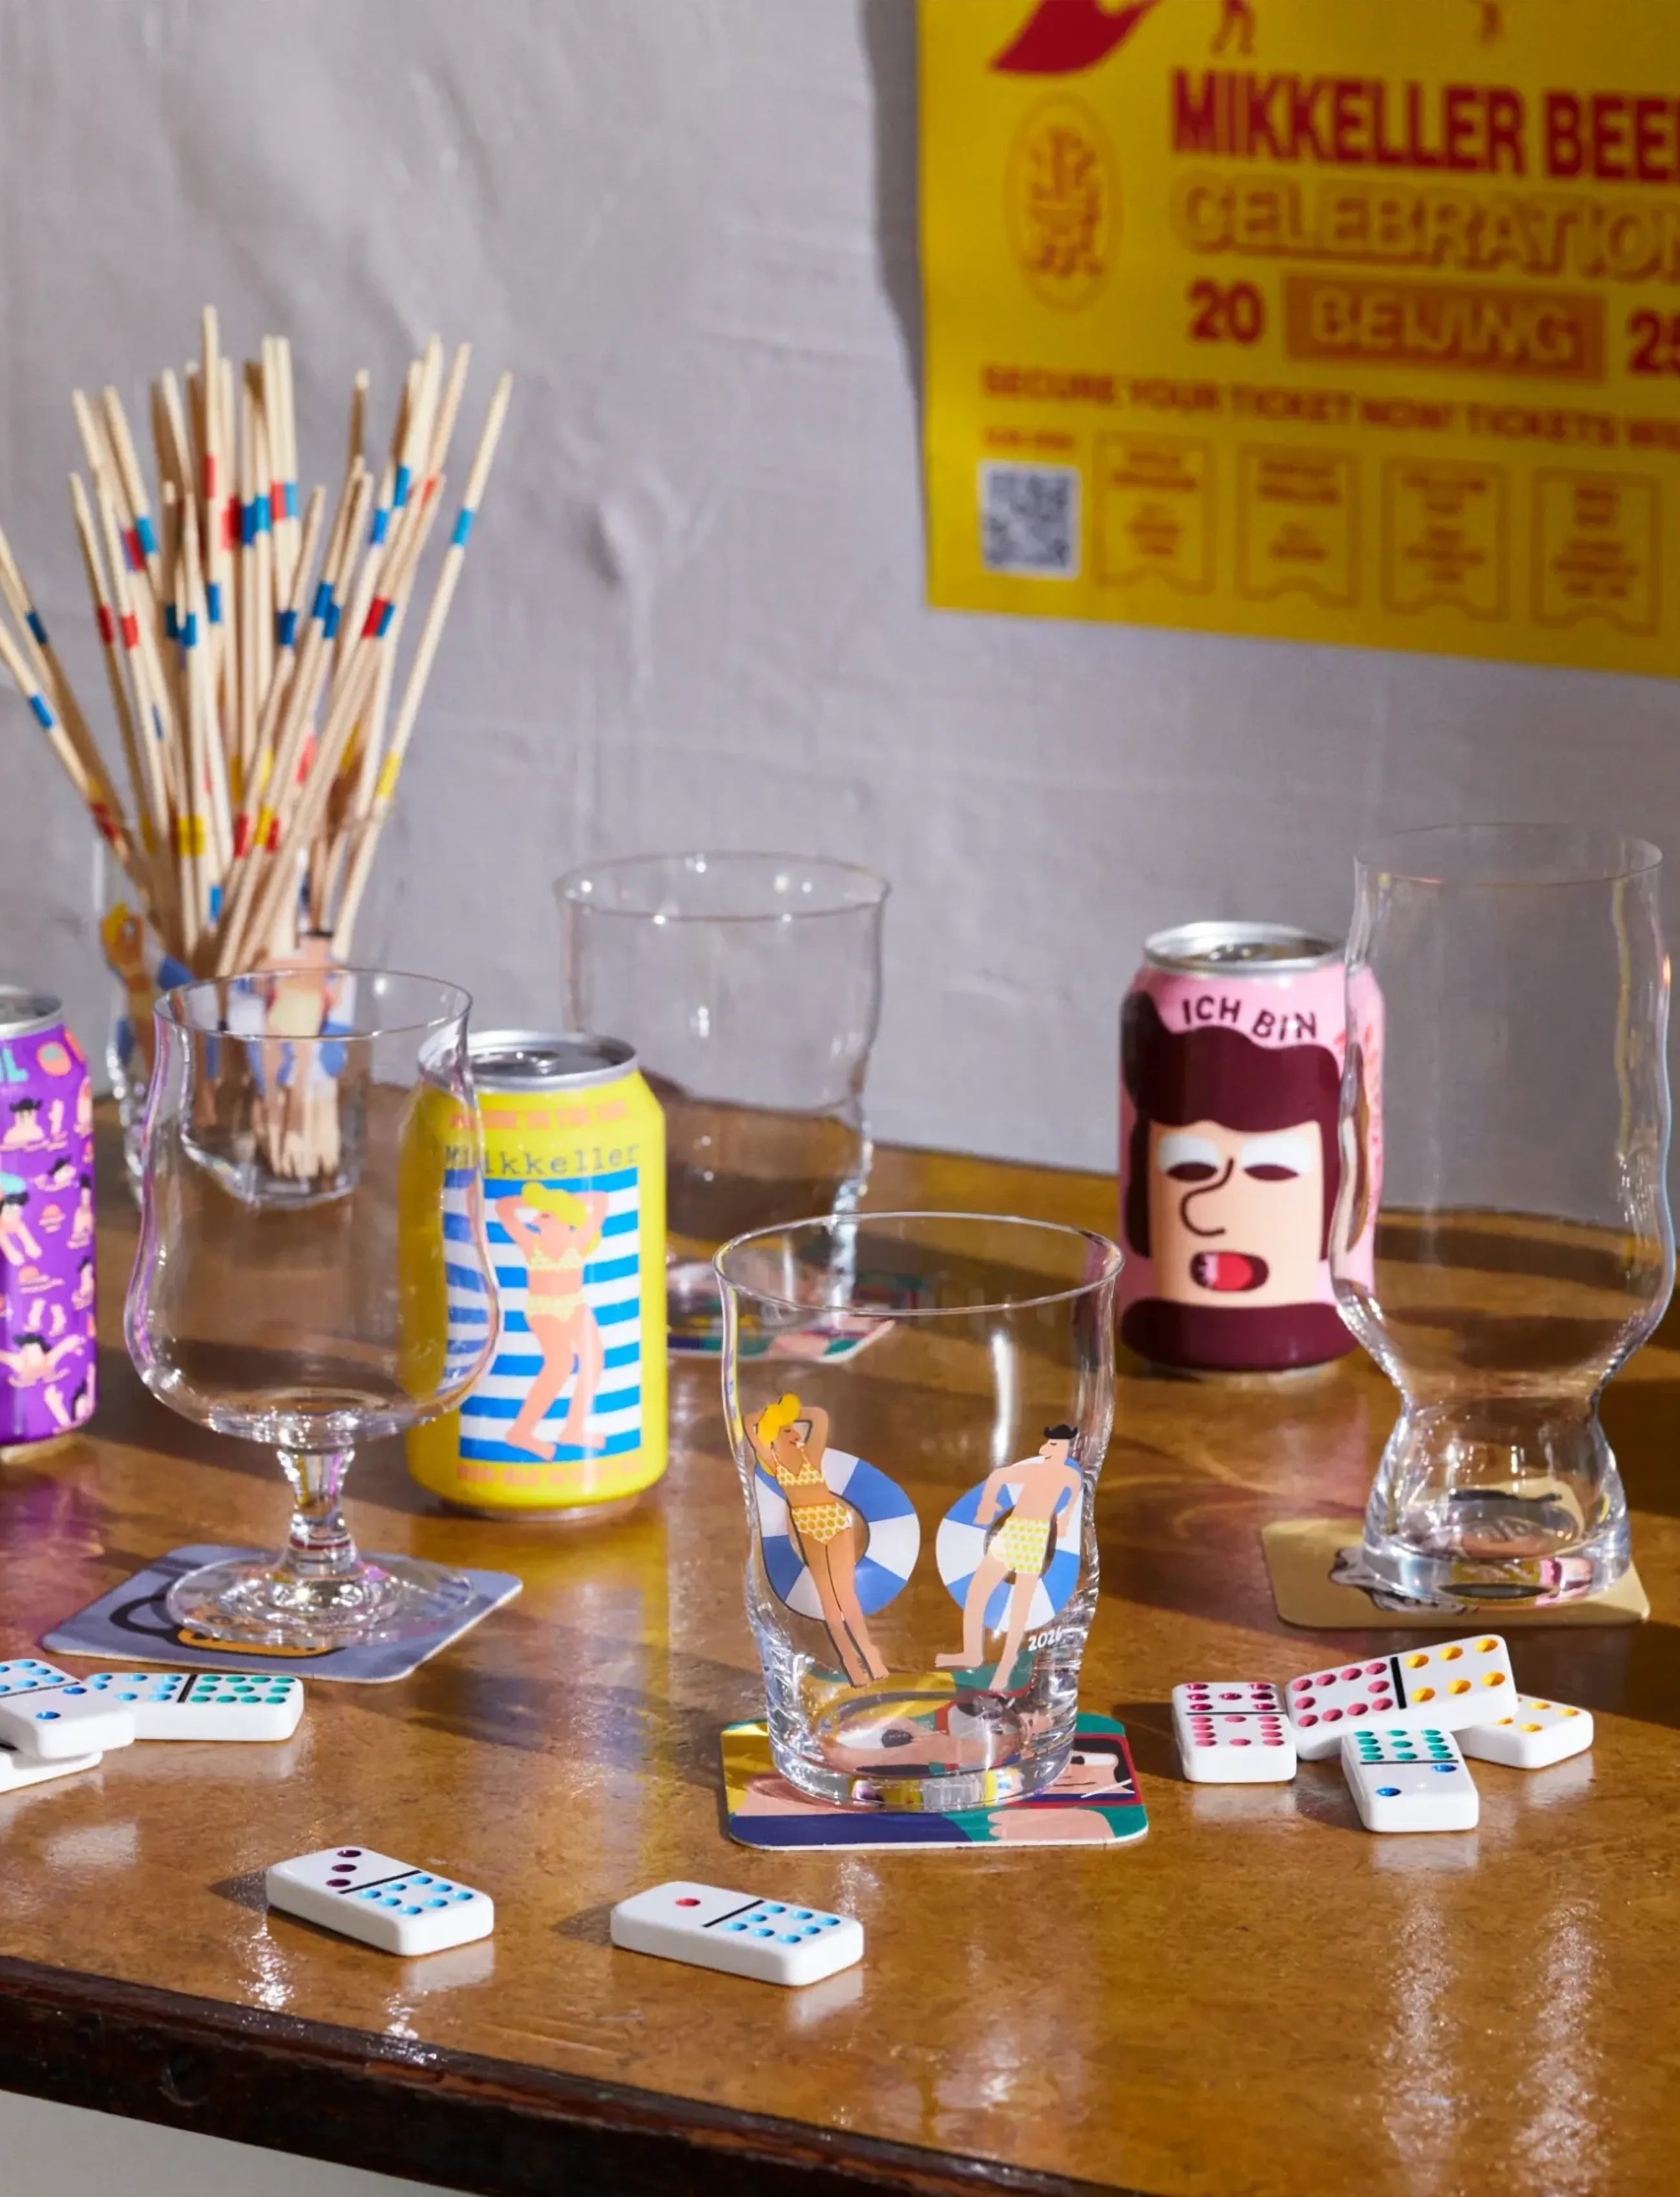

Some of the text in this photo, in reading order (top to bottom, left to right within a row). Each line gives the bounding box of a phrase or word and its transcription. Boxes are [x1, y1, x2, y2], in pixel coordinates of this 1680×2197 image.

[1172, 68, 1680, 182] MIKKELLER BEE
[1188, 278, 1680, 375] 20 BEIJING 2
[1182, 995, 1316, 1041] ICH BIN
